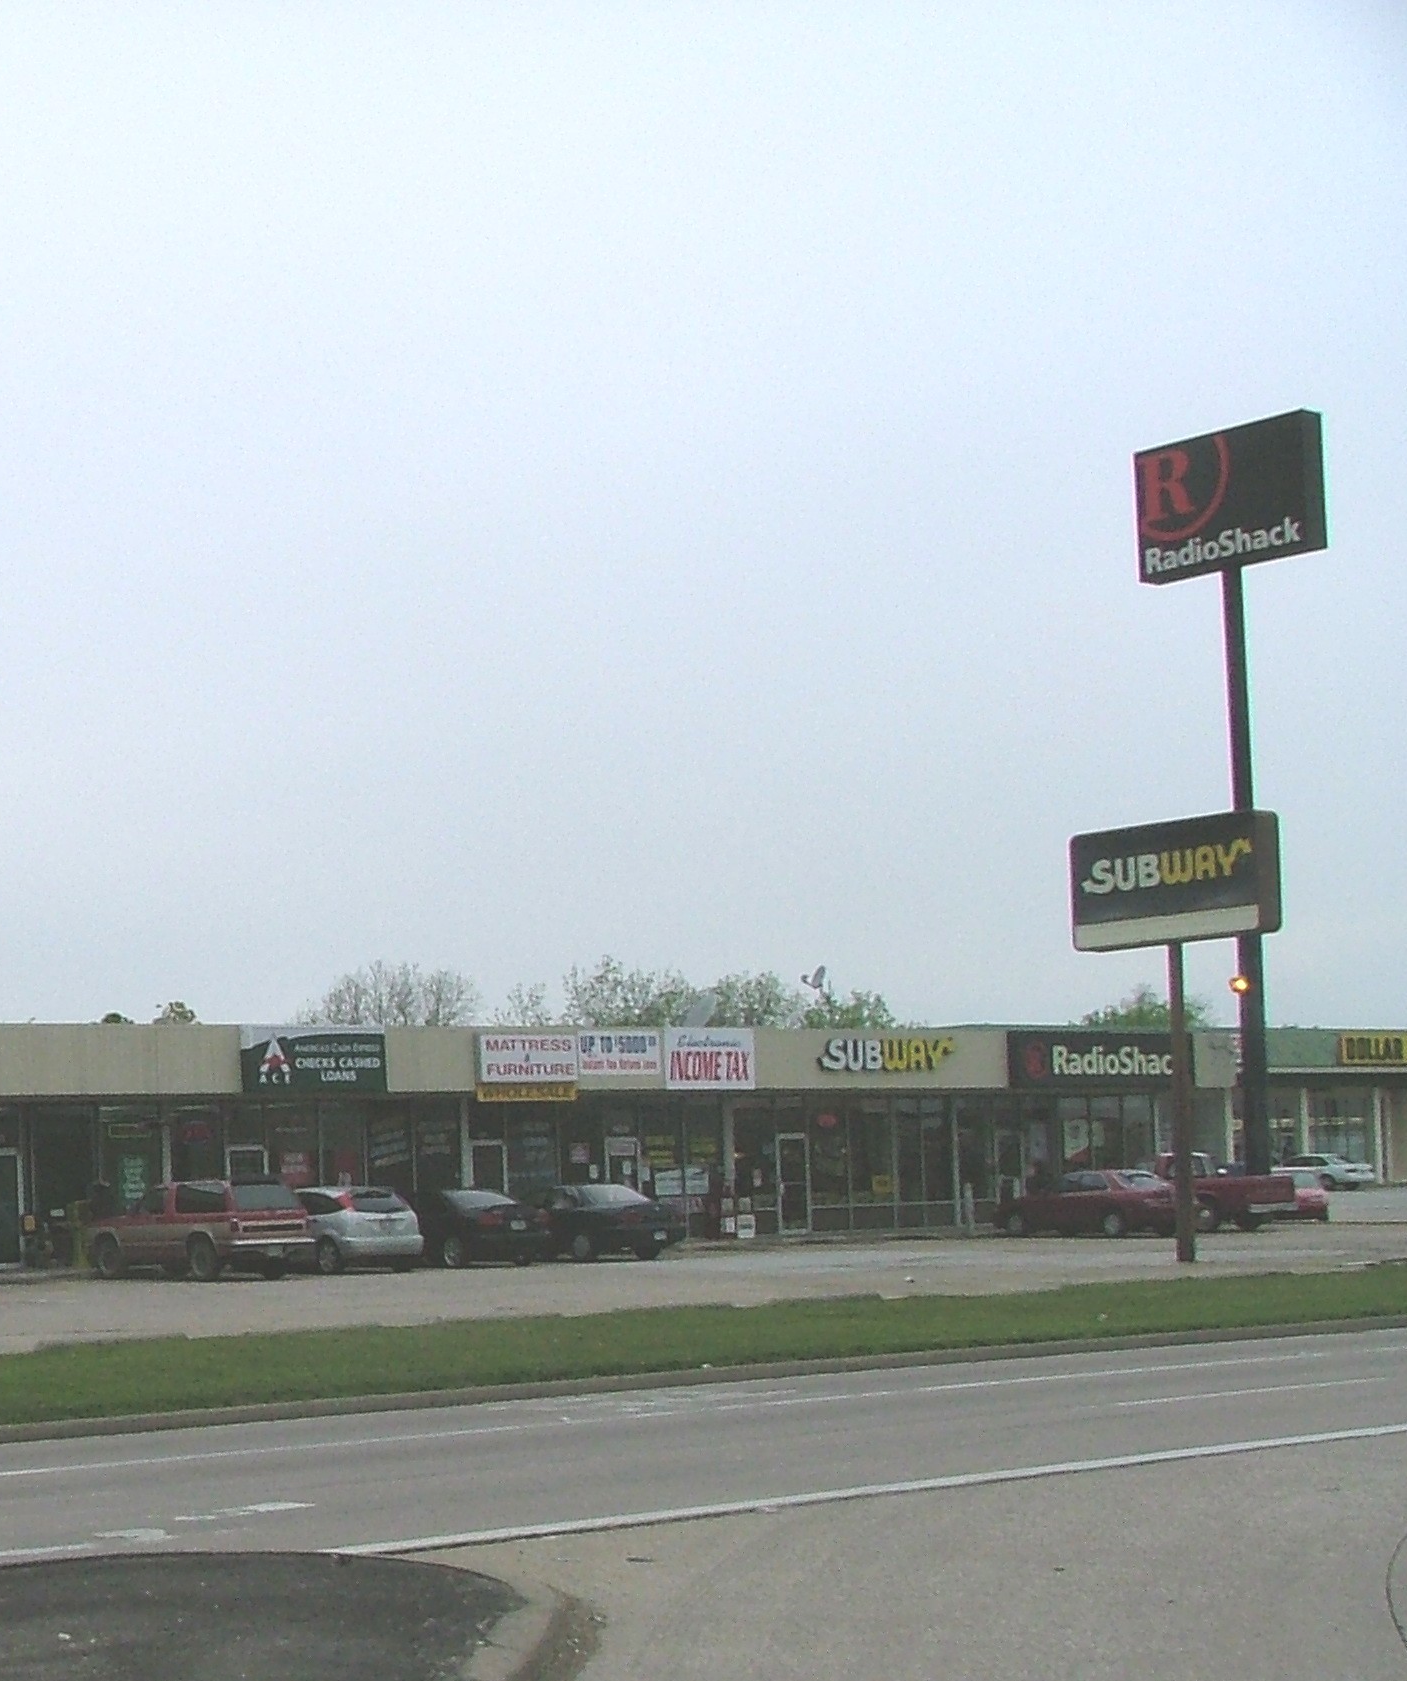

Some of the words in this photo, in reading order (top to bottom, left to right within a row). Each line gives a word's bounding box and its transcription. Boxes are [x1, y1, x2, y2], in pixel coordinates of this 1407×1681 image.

[1144, 516, 1303, 574] RadioShack
[1080, 837, 1254, 895] SUBWAY
[484, 1038, 573, 1052] MATTRESS
[580, 1035, 595, 1053] UP
[600, 1035, 613, 1053] TO
[819, 1037, 956, 1072] SUBWAY
[295, 1057, 336, 1069] CHECKS
[339, 1057, 381, 1069] CASHED
[486, 1062, 576, 1077] FURNITURE
[669, 1050, 722, 1081] INCOME
[725, 1050, 751, 1081] TAX
[1051, 1044, 1175, 1076] RadioShac
[320, 1070, 358, 1082] LOANS
